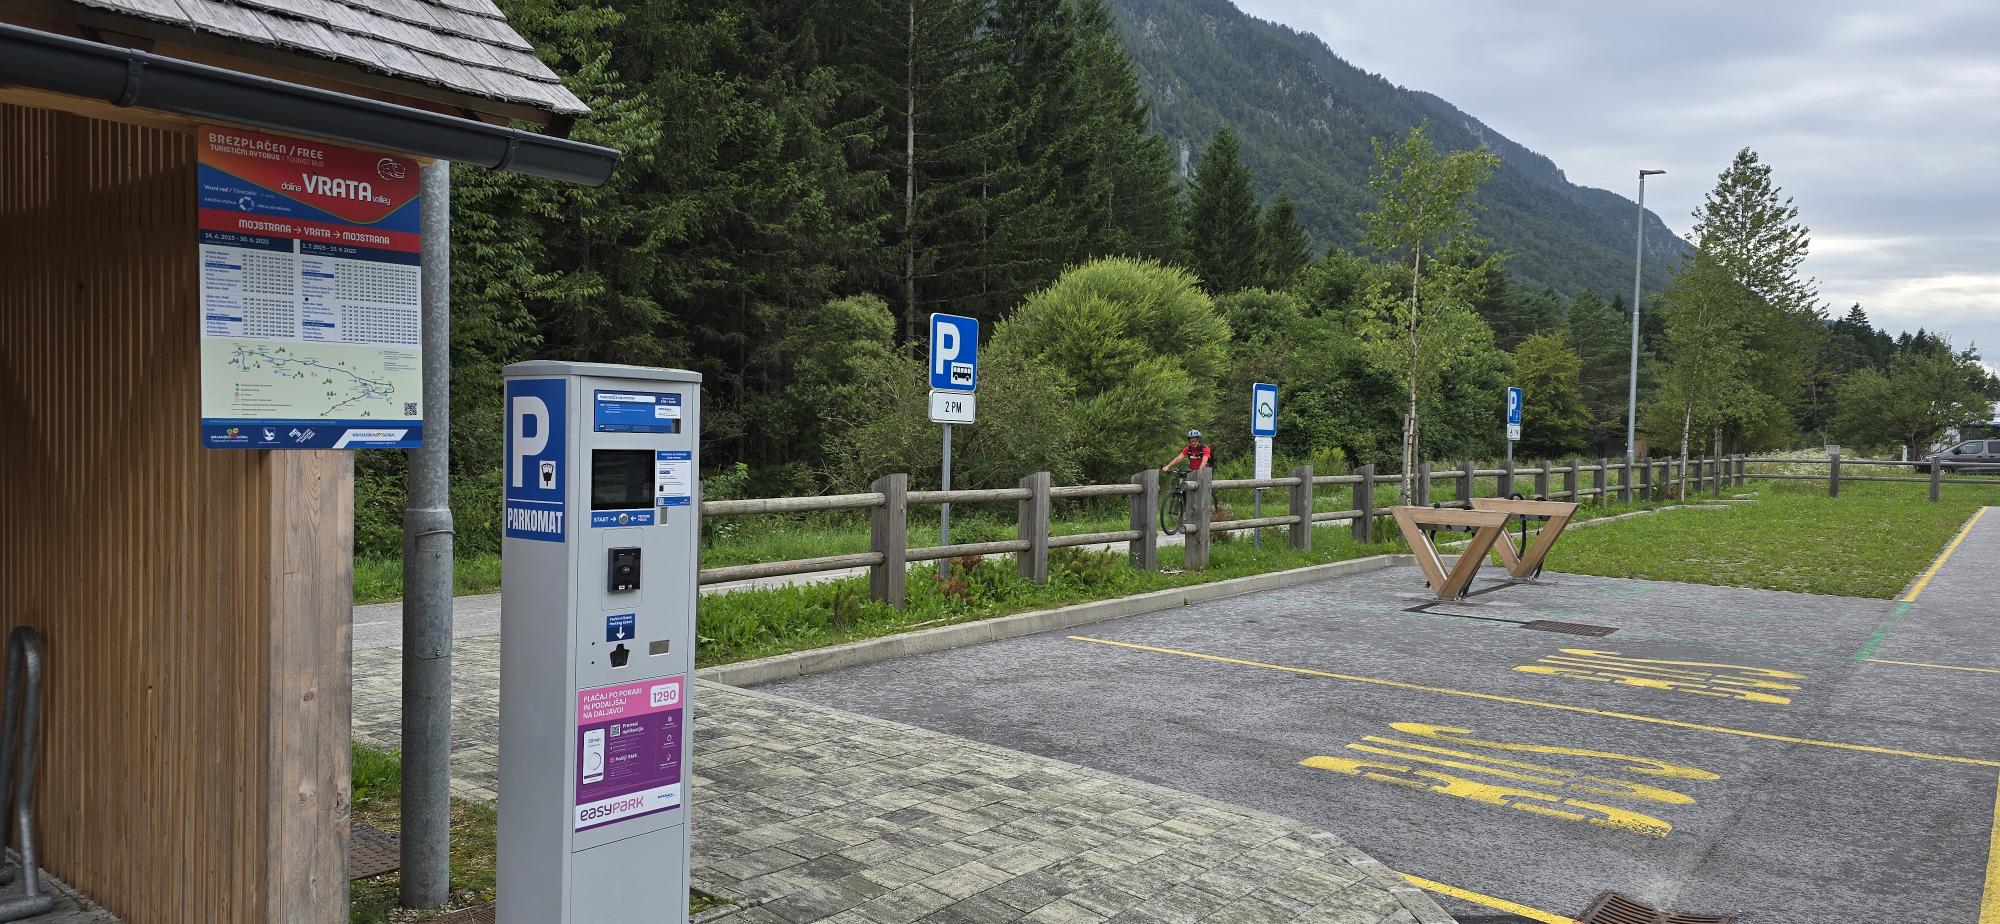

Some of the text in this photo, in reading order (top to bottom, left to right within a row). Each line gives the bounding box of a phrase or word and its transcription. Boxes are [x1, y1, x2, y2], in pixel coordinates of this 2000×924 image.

[209, 133, 287, 154] BREZPLAČEN
[297, 147, 324, 160] FREE
[209, 143, 248, 156] TURISTIČNI
[249, 148, 280, 161] AVTOBUS
[286, 154, 311, 166] TOURIST
[311, 158, 324, 168] BUS
[281, 182, 302, 193] dolina
[302, 173, 372, 202] VRATA
[373, 195, 391, 206] valley
[239, 219, 390, 245] MOJSTRANA VRATA MOJSTRANA
[936, 321, 960, 375] P
[945, 401, 962, 413] 2 PM
[1510, 390, 1517, 417] P
[513, 396, 550, 488] P
[507, 507, 563, 534] PARKOMAT
[583, 687, 642, 702] PLAČAJ PO PORABI
[583, 703, 590, 711] IN
[653, 689, 676, 703] 1290
[583, 707, 624, 719] NA DALJAVO!
[1300, 722, 1720, 838] BUS
